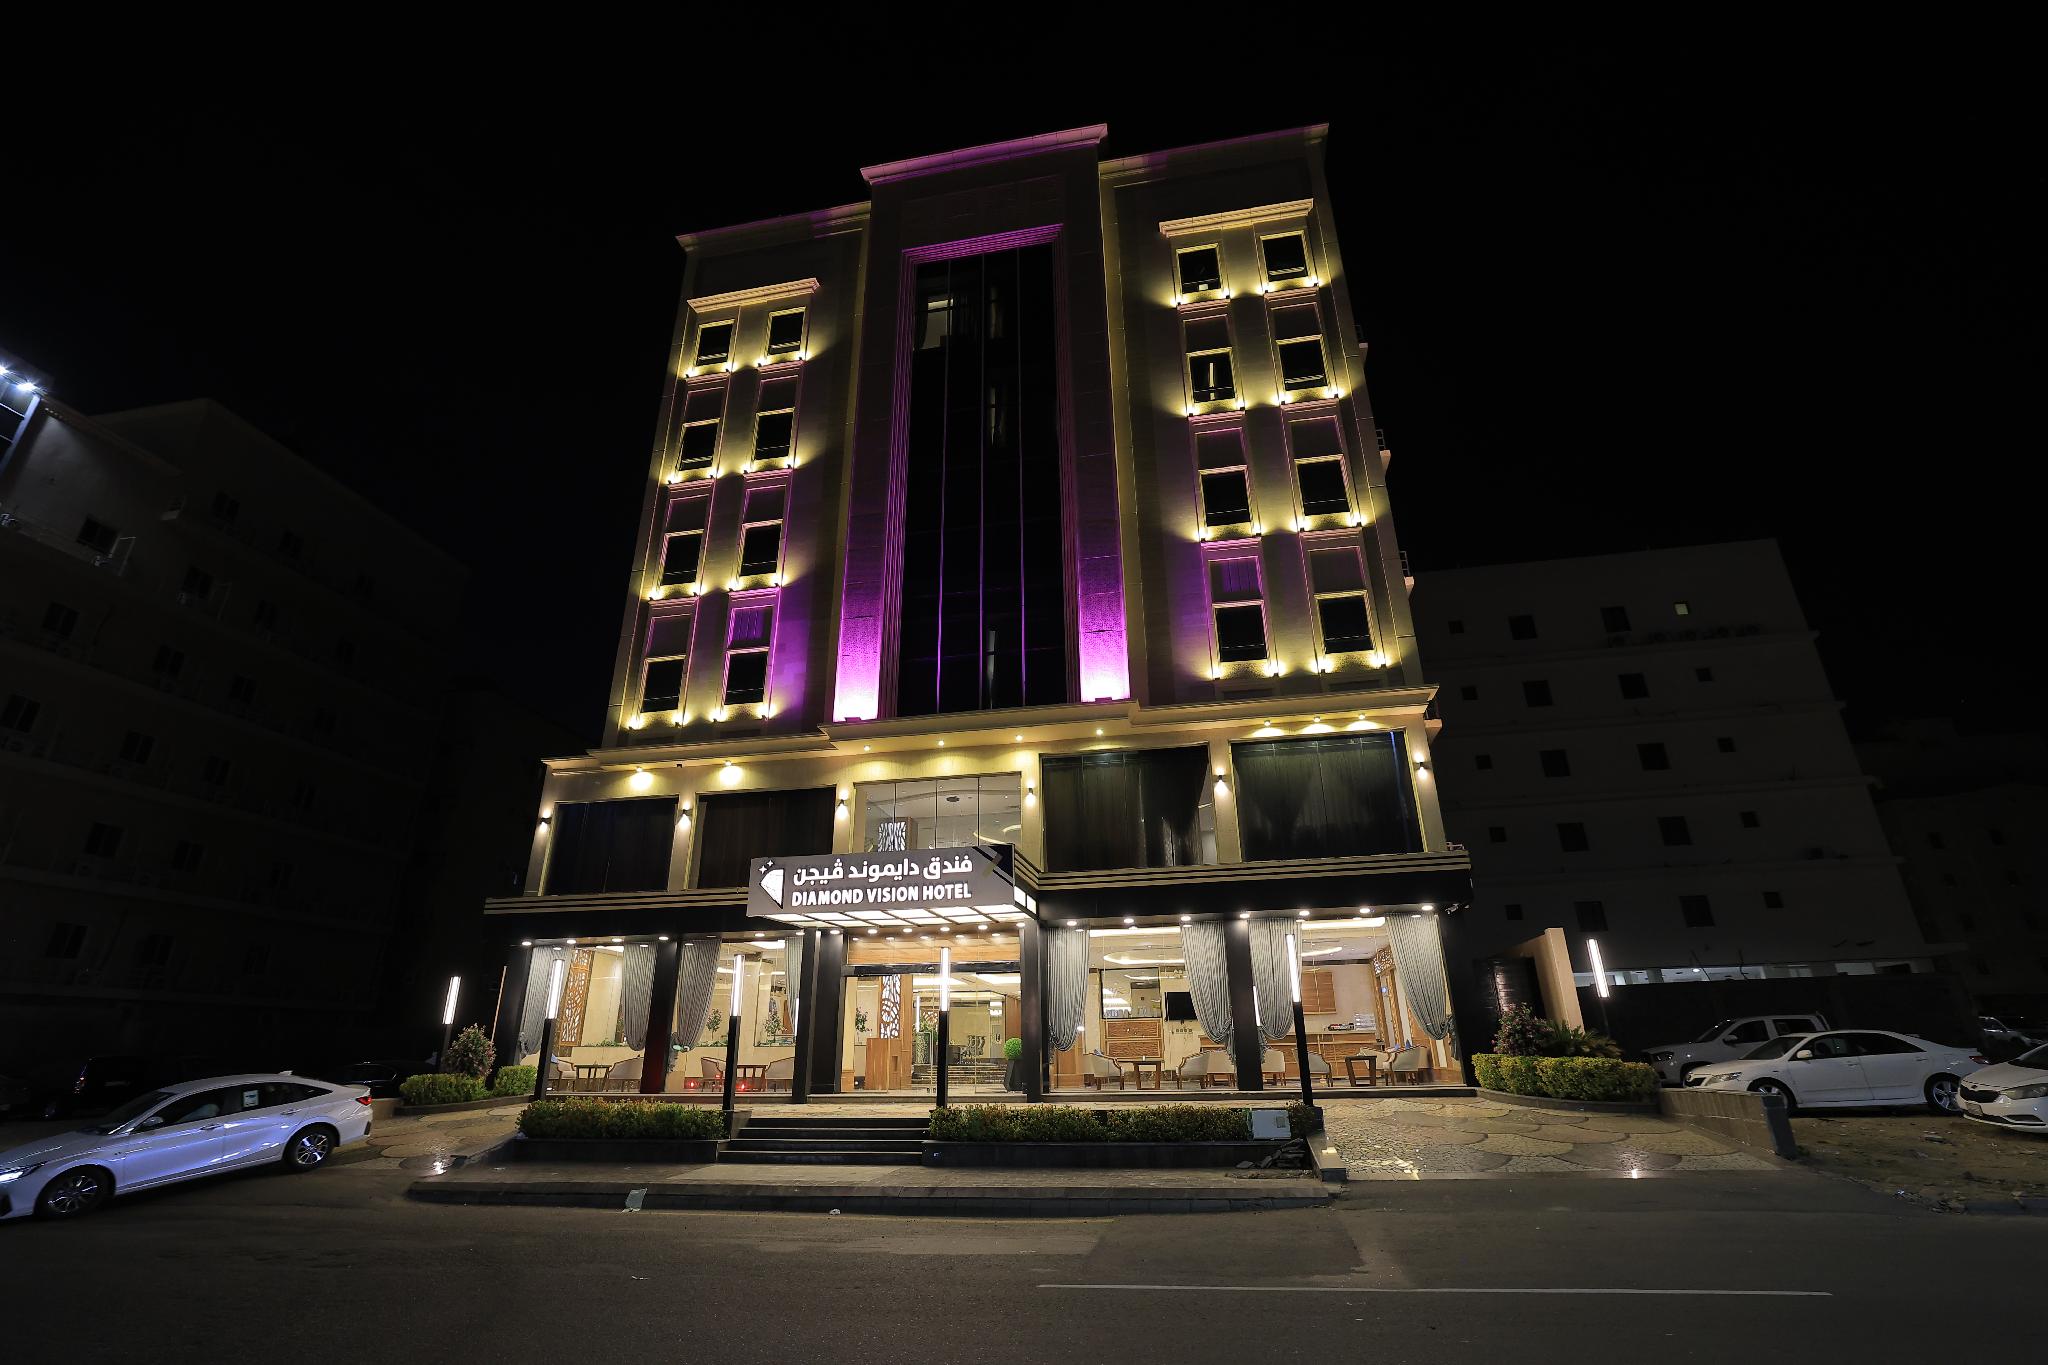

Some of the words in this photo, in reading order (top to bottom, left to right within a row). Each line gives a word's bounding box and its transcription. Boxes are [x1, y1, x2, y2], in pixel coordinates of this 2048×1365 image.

[847, 858, 920, 883] دايموند
[922, 855, 973, 880] فندق
[791, 888, 864, 907] DIAMOND
[866, 885, 919, 903] VISION
[922, 883, 972, 901] HOTEL
